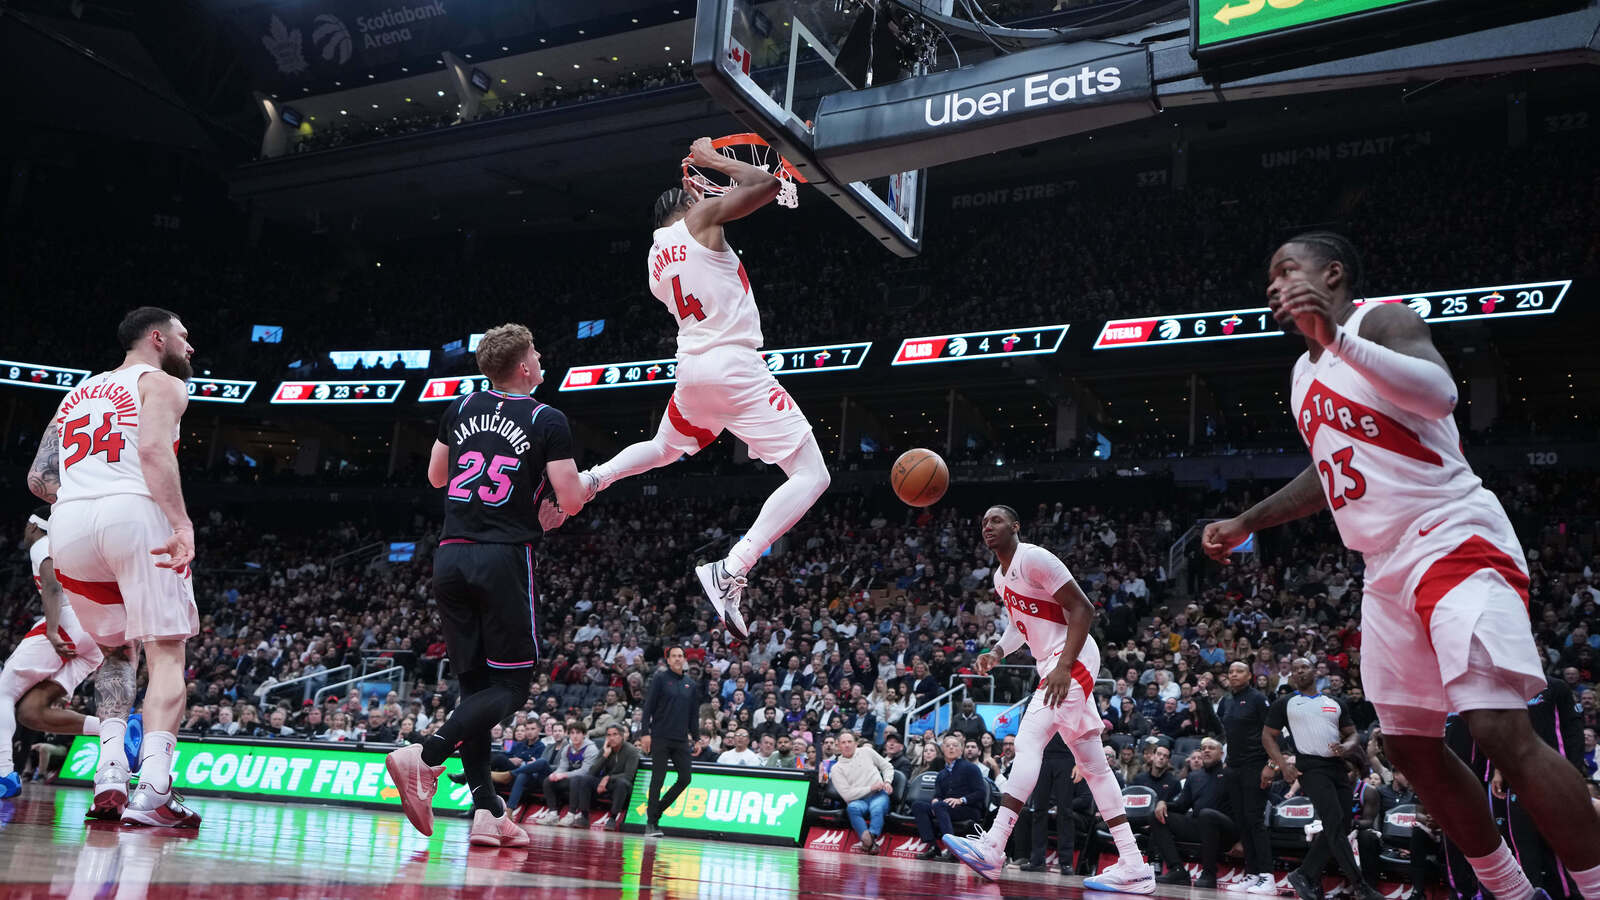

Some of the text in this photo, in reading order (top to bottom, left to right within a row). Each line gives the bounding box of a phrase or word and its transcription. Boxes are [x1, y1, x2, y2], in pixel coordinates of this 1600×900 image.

[356, 0, 447, 33] Scotiabank
[364, 25, 412, 49] Arena
[924, 65, 1121, 127] Uber Eats
[1261, 144, 1330, 168] UNION
[1136, 168, 1168, 187] 321
[952, 187, 1010, 209] FRONT
[653, 244, 687, 282] BARNES
[671, 274, 707, 321] 4
[1441, 290, 1544, 315] 25 20
[1105, 314, 1266, 340] STEALS 6 1
[979, 337, 989, 352] 4
[1033, 333, 1041, 348] 1
[792, 350, 851, 367] 11 7
[9, 366, 73, 386] 9 12
[480, 379, 490, 392] 9
[625, 367, 640, 381] 40
[222, 385, 240, 397] 24
[334, 385, 386, 398] 23 6
[62, 412, 126, 472] 54
[453, 411, 531, 455] JAKUČIONIS
[1526, 451, 1558, 465] 120
[448, 450, 521, 507] 25
[1318, 446, 1367, 511] 23
[1016, 620, 1029, 641] 9
[186, 751, 310, 792] COURT
[646, 785, 798, 826] UBWAY
